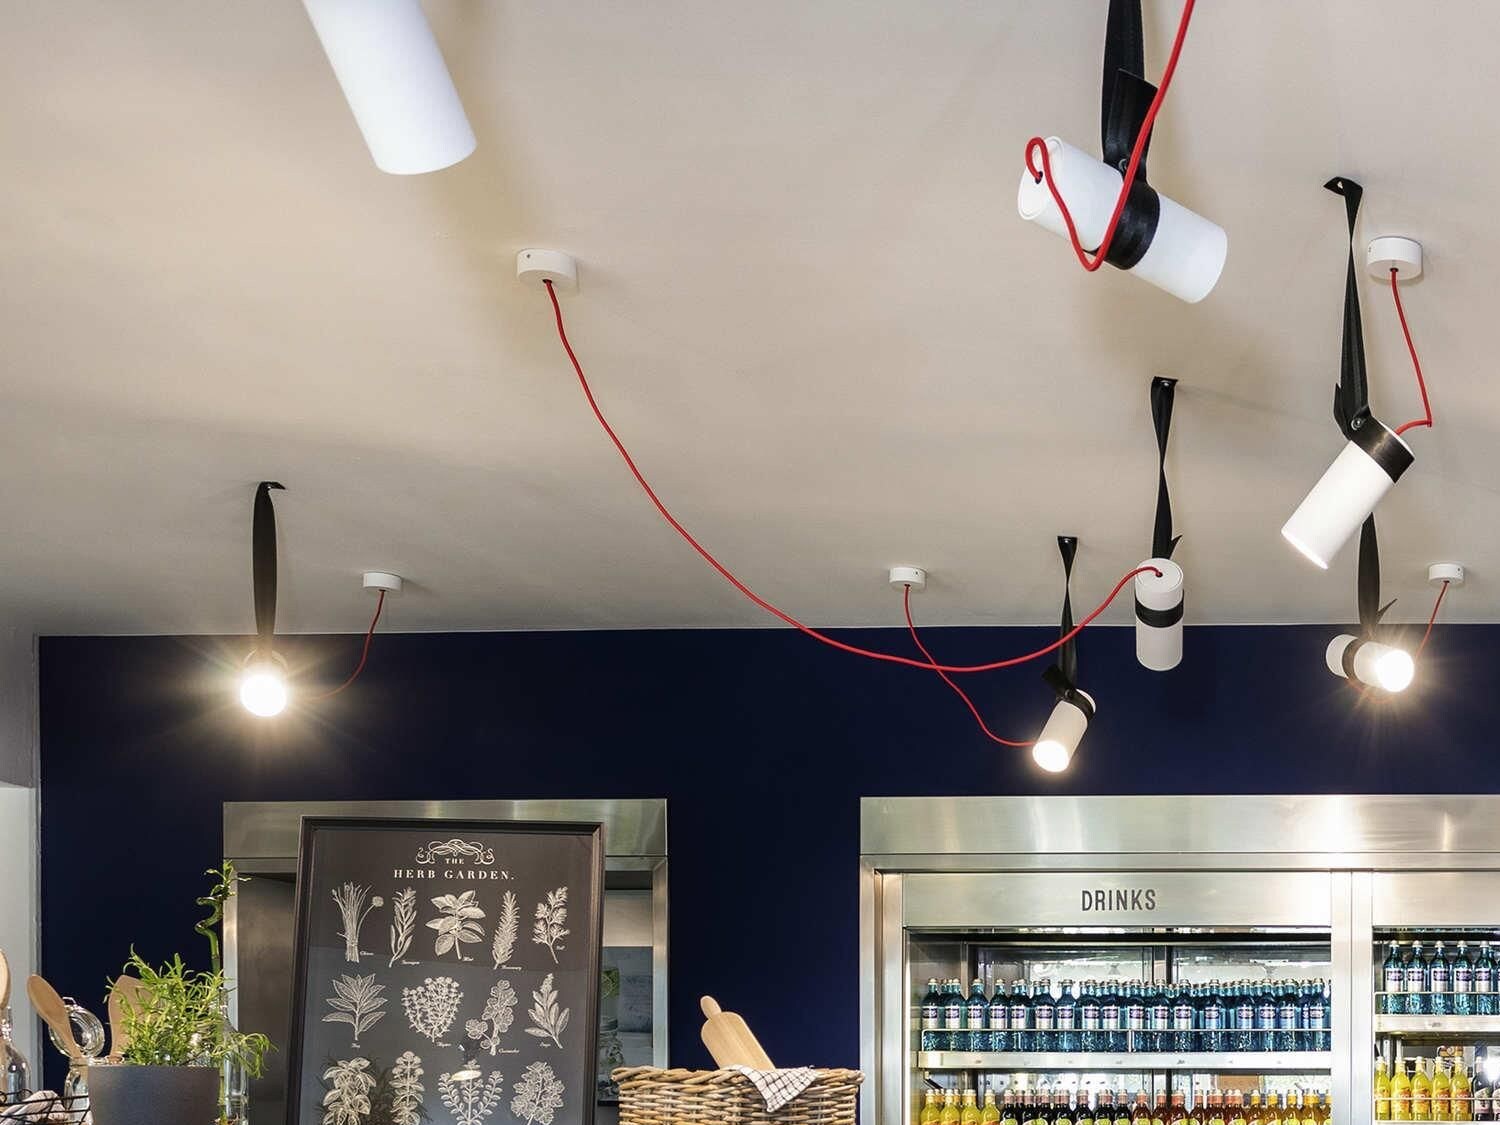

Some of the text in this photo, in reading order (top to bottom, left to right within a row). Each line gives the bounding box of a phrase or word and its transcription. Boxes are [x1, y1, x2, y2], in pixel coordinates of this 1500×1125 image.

[393, 869, 515, 881] HERB GARDEN.
[1081, 889, 1156, 911] DRINKS
